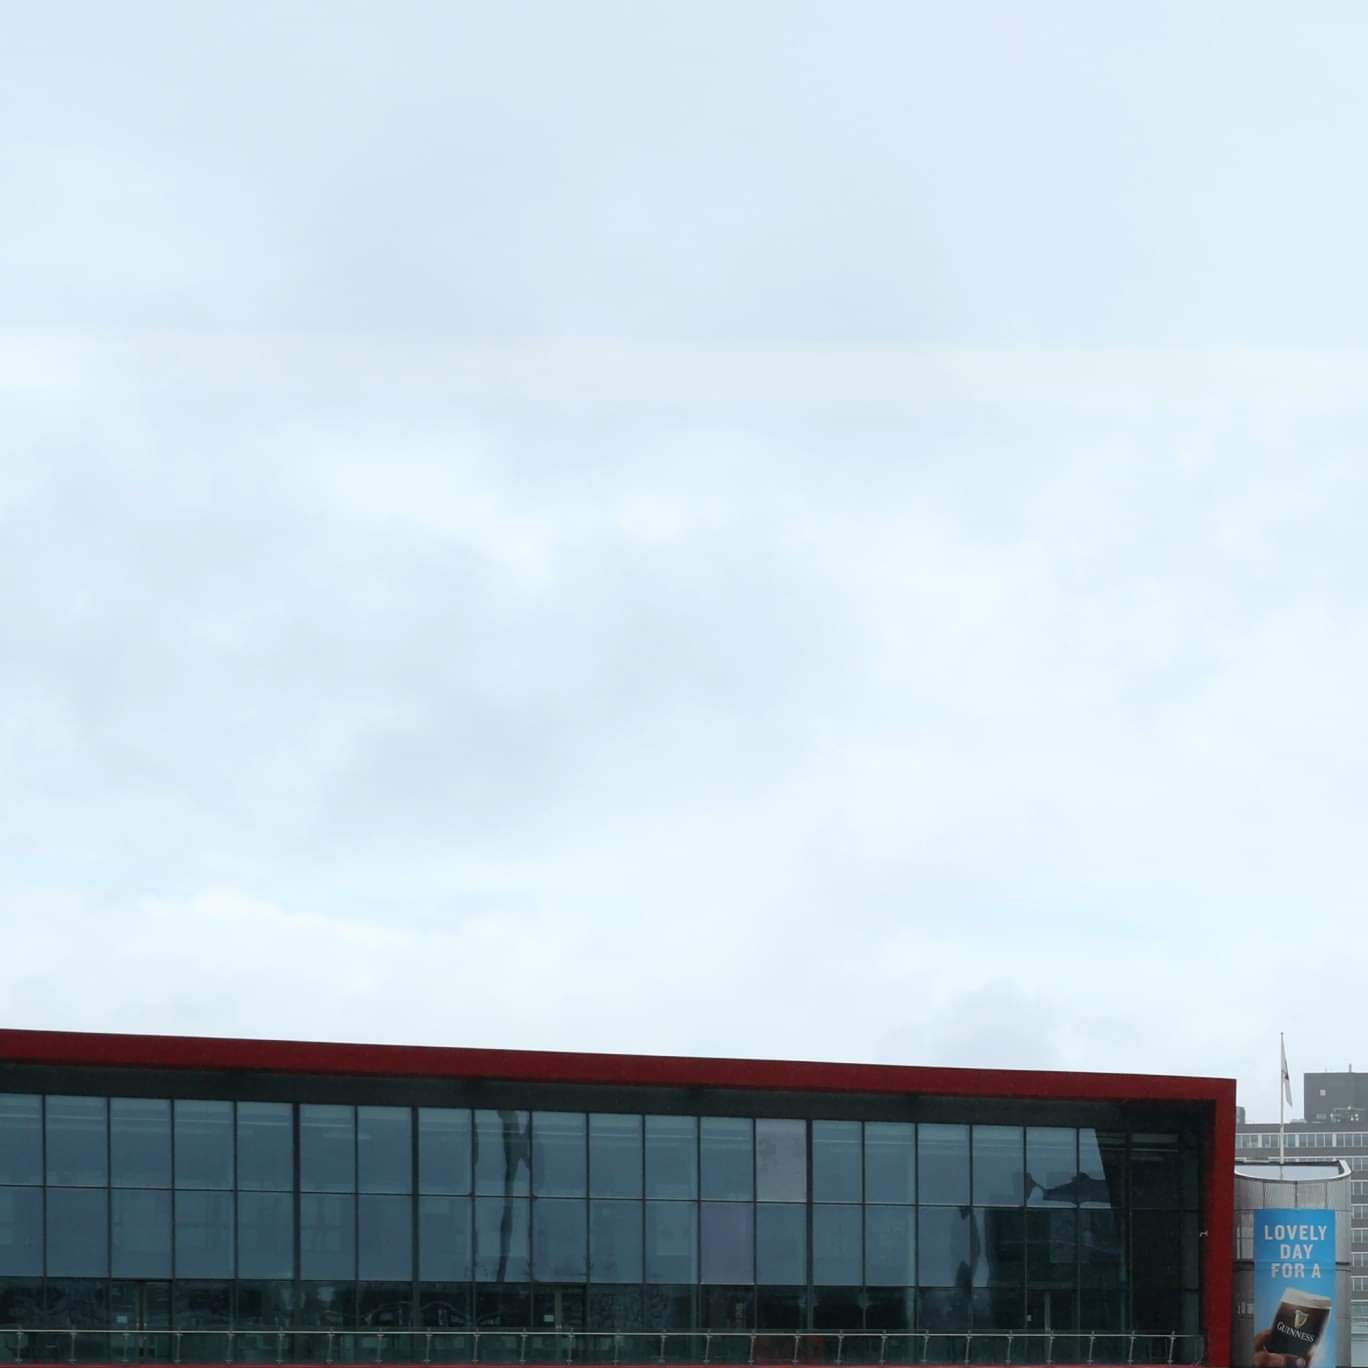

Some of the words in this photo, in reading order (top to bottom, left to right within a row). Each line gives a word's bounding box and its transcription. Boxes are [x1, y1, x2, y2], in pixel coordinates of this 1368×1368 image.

[1264, 1225, 1327, 1241] LOVELY
[1279, 1244, 1313, 1260] DAY
[1271, 1263, 1305, 1279] FOR
[1312, 1263, 1321, 1279] A
[1276, 1321, 1315, 1344] GUINNESS
